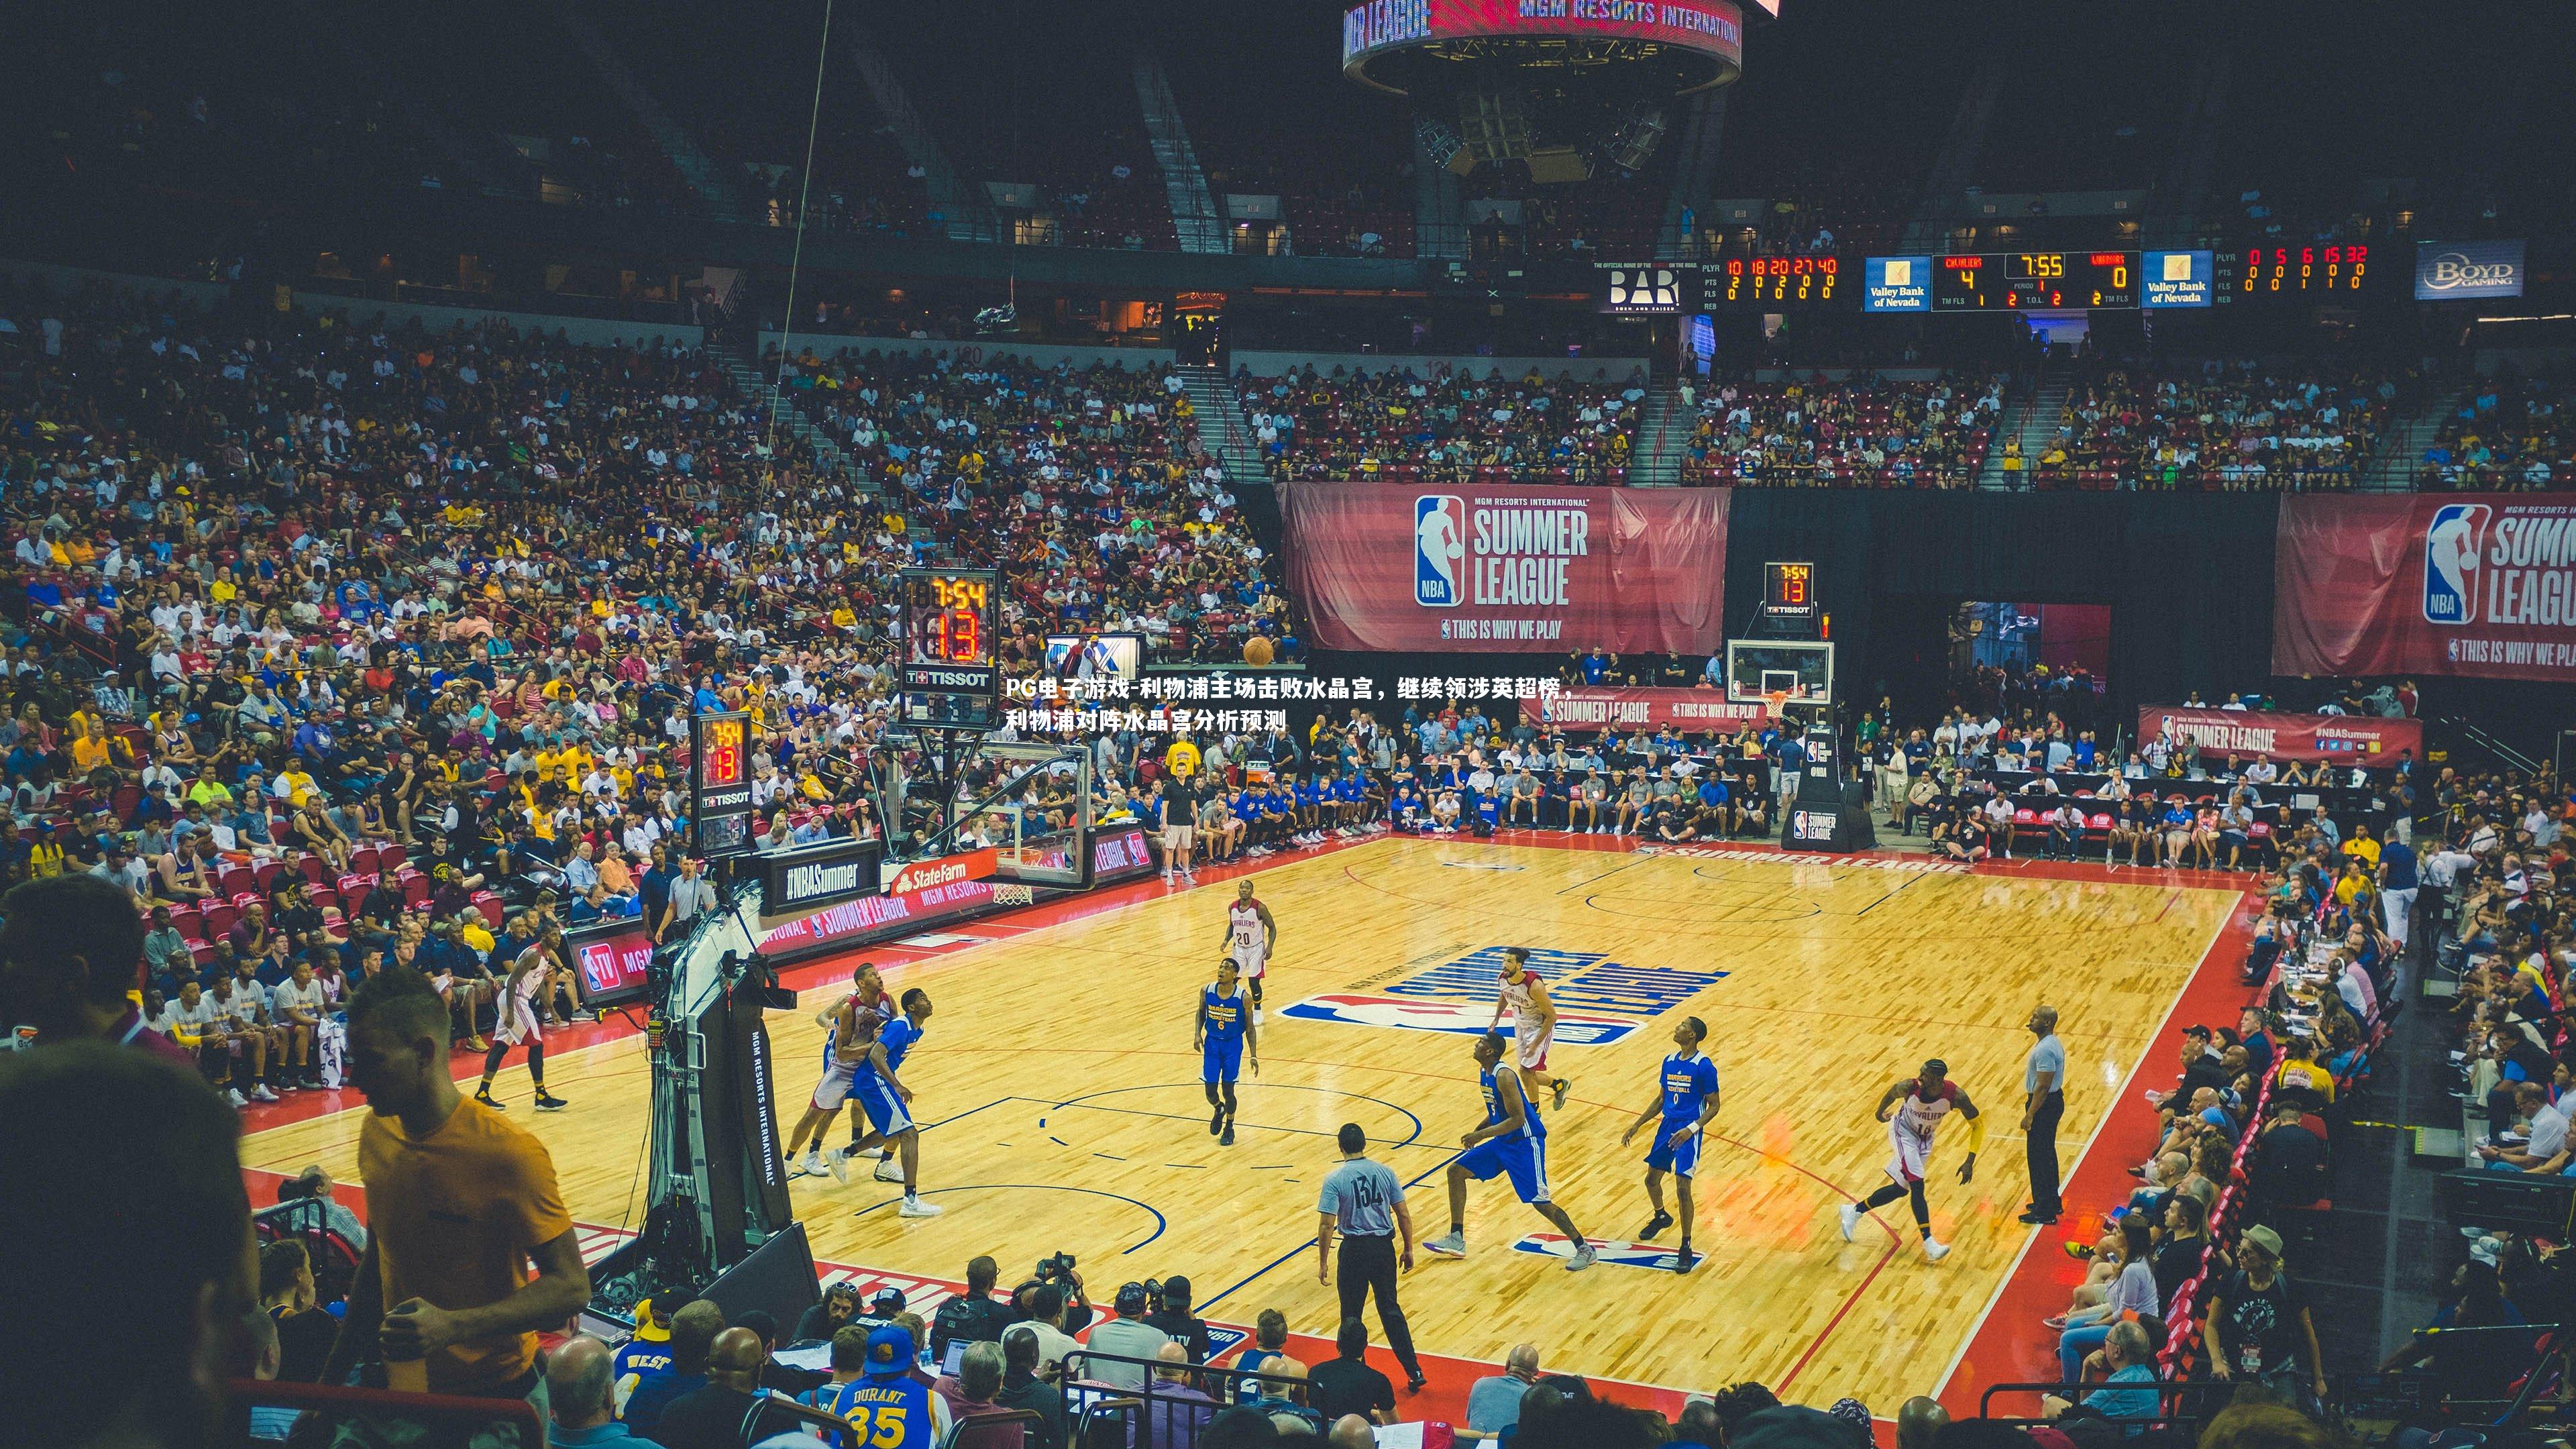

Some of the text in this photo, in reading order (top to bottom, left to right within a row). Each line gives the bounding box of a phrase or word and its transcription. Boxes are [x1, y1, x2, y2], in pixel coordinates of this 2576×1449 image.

[1572, 0, 1655, 23] RESORTS
[2216, 254, 2236, 262] PLYR
[2250, 250, 2260, 264] 0
[2276, 249, 2286, 264] 5
[2302, 248, 2313, 263] 6
[2324, 248, 2340, 262] 15
[2347, 247, 2367, 262] 32
[1702, 264, 1720, 272] PLYR
[1728, 262, 1741, 274] 10
[1752, 261, 1764, 274] 18
[1771, 261, 1788, 274] 20
[1795, 260, 1811, 273] 27
[1819, 260, 1836, 272] 40
[2021, 255, 2063, 276] 7:55
[2250, 266, 2257, 278] 0
[2276, 266, 2283, 278] 0
[2302, 265, 2310, 276] 0
[2330, 265, 2337, 276] 0
[2356, 264, 2364, 276] 0
[2436, 261, 2513, 280] BOYD
[1732, 277, 1739, 288] 2
[1756, 276, 1762, 286] 0
[1779, 276, 1786, 287] 2
[1803, 276, 1810, 286] 0
[1827, 276, 1833, 286] 0
[1961, 271, 1974, 289] 4
[2114, 266, 2126, 287] 0
[2245, 280, 2253, 291] 0
[2302, 279, 2306, 289] 1
[2329, 279, 2332, 288] 1
[2351, 276, 2359, 288] 0
[2461, 277, 2513, 286] GAMING
[1871, 287, 1924, 298] Valley Bank
[2040, 280, 2043, 291] 1
[2148, 282, 2206, 293] Valley Bank
[1729, 289, 1735, 300] 0
[1756, 288, 1759, 299] 1
[1775, 288, 1782, 299] 0
[1799, 288, 1806, 299] 0
[1823, 287, 1830, 298] 0
[1980, 295, 1984, 306] 1
[2008, 292, 2016, 306] 2
[2053, 294, 2061, 305] 2
[2093, 292, 2101, 305] 2
[2152, 293, 2201, 303] of Nevada
[1874, 299, 1919, 307] of Nevada
[1529, 498, 1588, 506] INTERNATIONAL
[1474, 509, 1588, 555] SUMMER
[2491, 518, 2576, 566] SUMM
[1781, 566, 1807, 580] 7:54
[1474, 557, 1570, 605] LEAGUE
[932, 579, 985, 609] 7:54
[1421, 580, 1444, 598] NBA
[1784, 581, 1803, 602] 13
[2431, 594, 2455, 614] NBA
[2487, 570, 2576, 626] LEAGU
[939, 612, 978, 661] 13
[1452, 620, 1562, 639] THIS IS WHY WE PLAY
[2461, 640, 2489, 662] THIS
[2491, 641, 2503, 662] IS
[2506, 641, 2534, 664] WHY
[2536, 643, 2555, 665] WE
[928, 672, 989, 686] TISSOT
[1556, 701, 1650, 722] SUMMER LEAGUE
[1680, 704, 1758, 718] THIS IS WHY WE PLAY
[2232, 727, 2275, 752] LEAGUE
[2316, 729, 2380, 740] #NBASummer
[718, 749, 735, 780] 13
[1811, 767, 1827, 777] @NBA
[716, 792, 749, 806] TISSOT
[1809, 815, 1836, 828] SUMMER
[1808, 828, 1831, 840] LEAGUE
[1098, 840, 1128, 871] LEAGUE
[1134, 840, 1146, 858] TV
[1668, 848, 1976, 873] SUMMER LEAGUE
[787, 864, 858, 900] #NBASummer
[822, 899, 872, 934] SUMMER
[871, 896, 910, 924] LEAGUE
[920, 887, 945, 906] MGM
[947, 881, 988, 900] RESORTS
[1236, 932, 1250, 945] 20
[595, 948, 653, 980] TV MGM
[1504, 991, 1529, 1006] AVALIERS
[1208, 1005, 1236, 1014] WARRIORS
[1218, 1022, 1225, 1030] 6
[752, 1032, 773, 1185] MGM RESORTS INTERNATIONAL
[1350, 1175, 1383, 1208] 134
[627, 1355, 671, 1370] WEST
[853, 1388, 907, 1404] DURANT
[840, 1406, 906, 1449] 35
